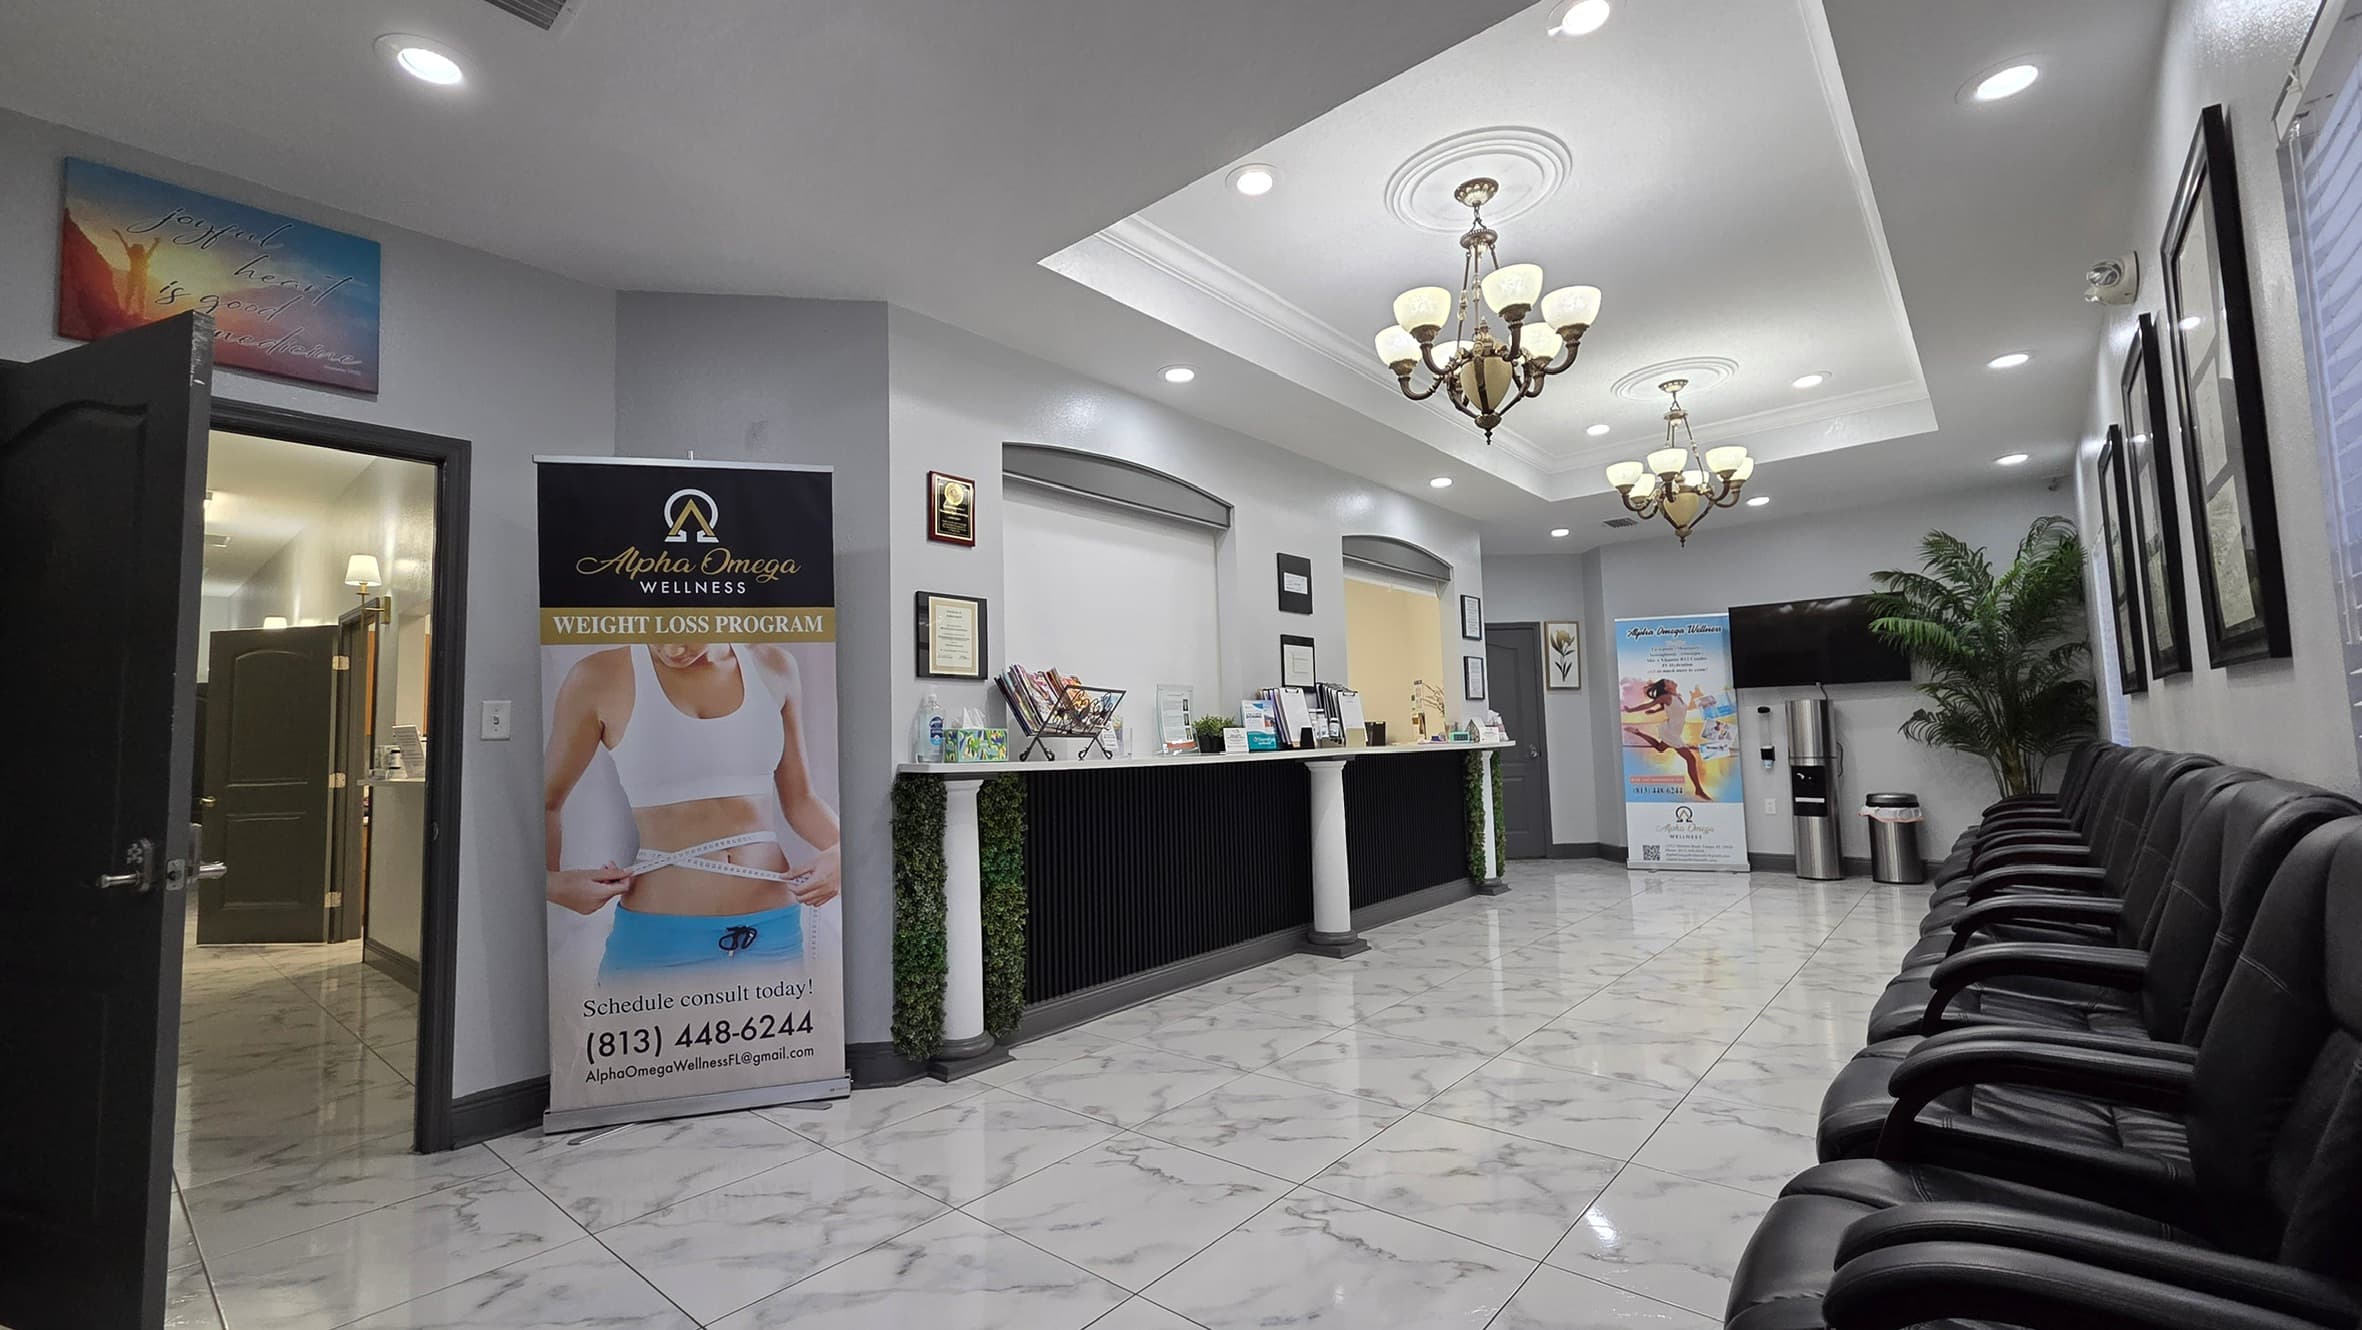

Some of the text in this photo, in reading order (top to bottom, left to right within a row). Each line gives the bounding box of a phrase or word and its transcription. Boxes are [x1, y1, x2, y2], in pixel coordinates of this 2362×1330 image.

[126, 207, 292, 249] joyful
[155, 280, 193, 305] is
[234, 254, 353, 305] heart
[576, 545, 801, 584] Alpha Omega
[639, 580, 746, 594] WELLNESS
[552, 615, 823, 635] WEIGHT LOSS PROGRAM
[1627, 624, 1722, 640] Alpha Omega Wellness
[583, 978, 814, 1018] Schedule consult today!
[586, 1009, 814, 1065] (813) 448-6244
[585, 1047, 815, 1085] AlphaOmegaWellnessFL@gmail.com
